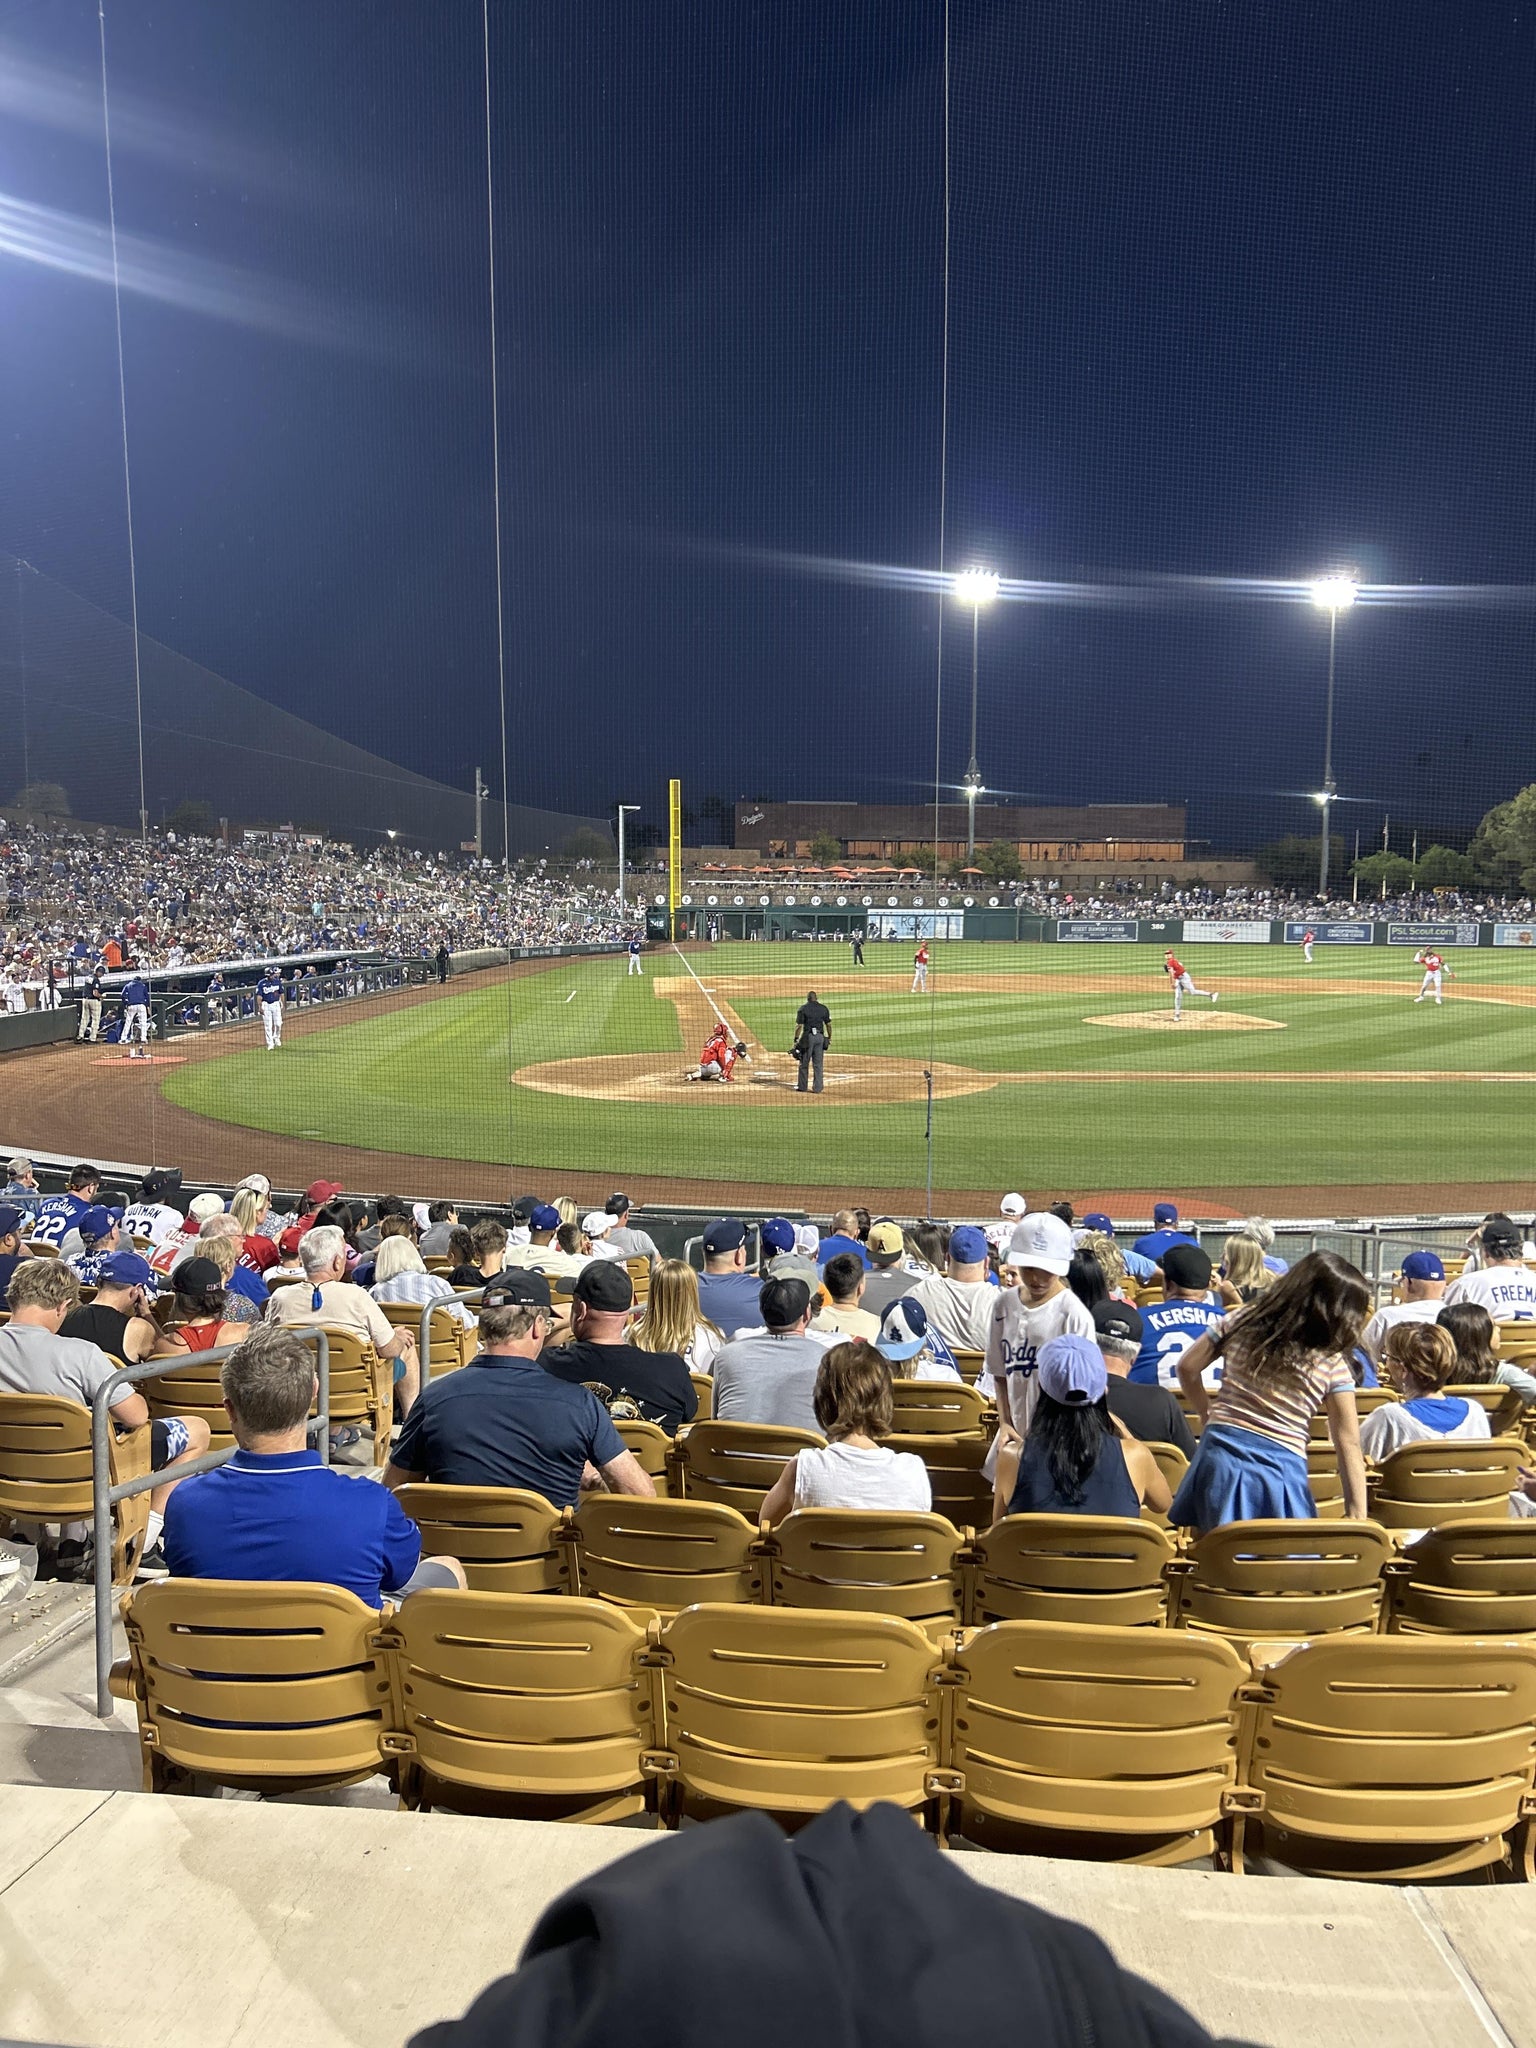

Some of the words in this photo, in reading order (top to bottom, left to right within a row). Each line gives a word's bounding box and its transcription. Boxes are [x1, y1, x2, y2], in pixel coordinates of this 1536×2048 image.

[1391, 927, 1407, 935] PSL
[1409, 926, 1455, 936] Scout.com
[41, 1201, 78, 1218] KERSHAW
[127, 1205, 162, 1219] OUTMAN
[30, 1214, 67, 1246] 22
[125, 1219, 153, 1240] 33
[877, 1238, 887, 1252] A
[1491, 1284, 1536, 1304] FREEM
